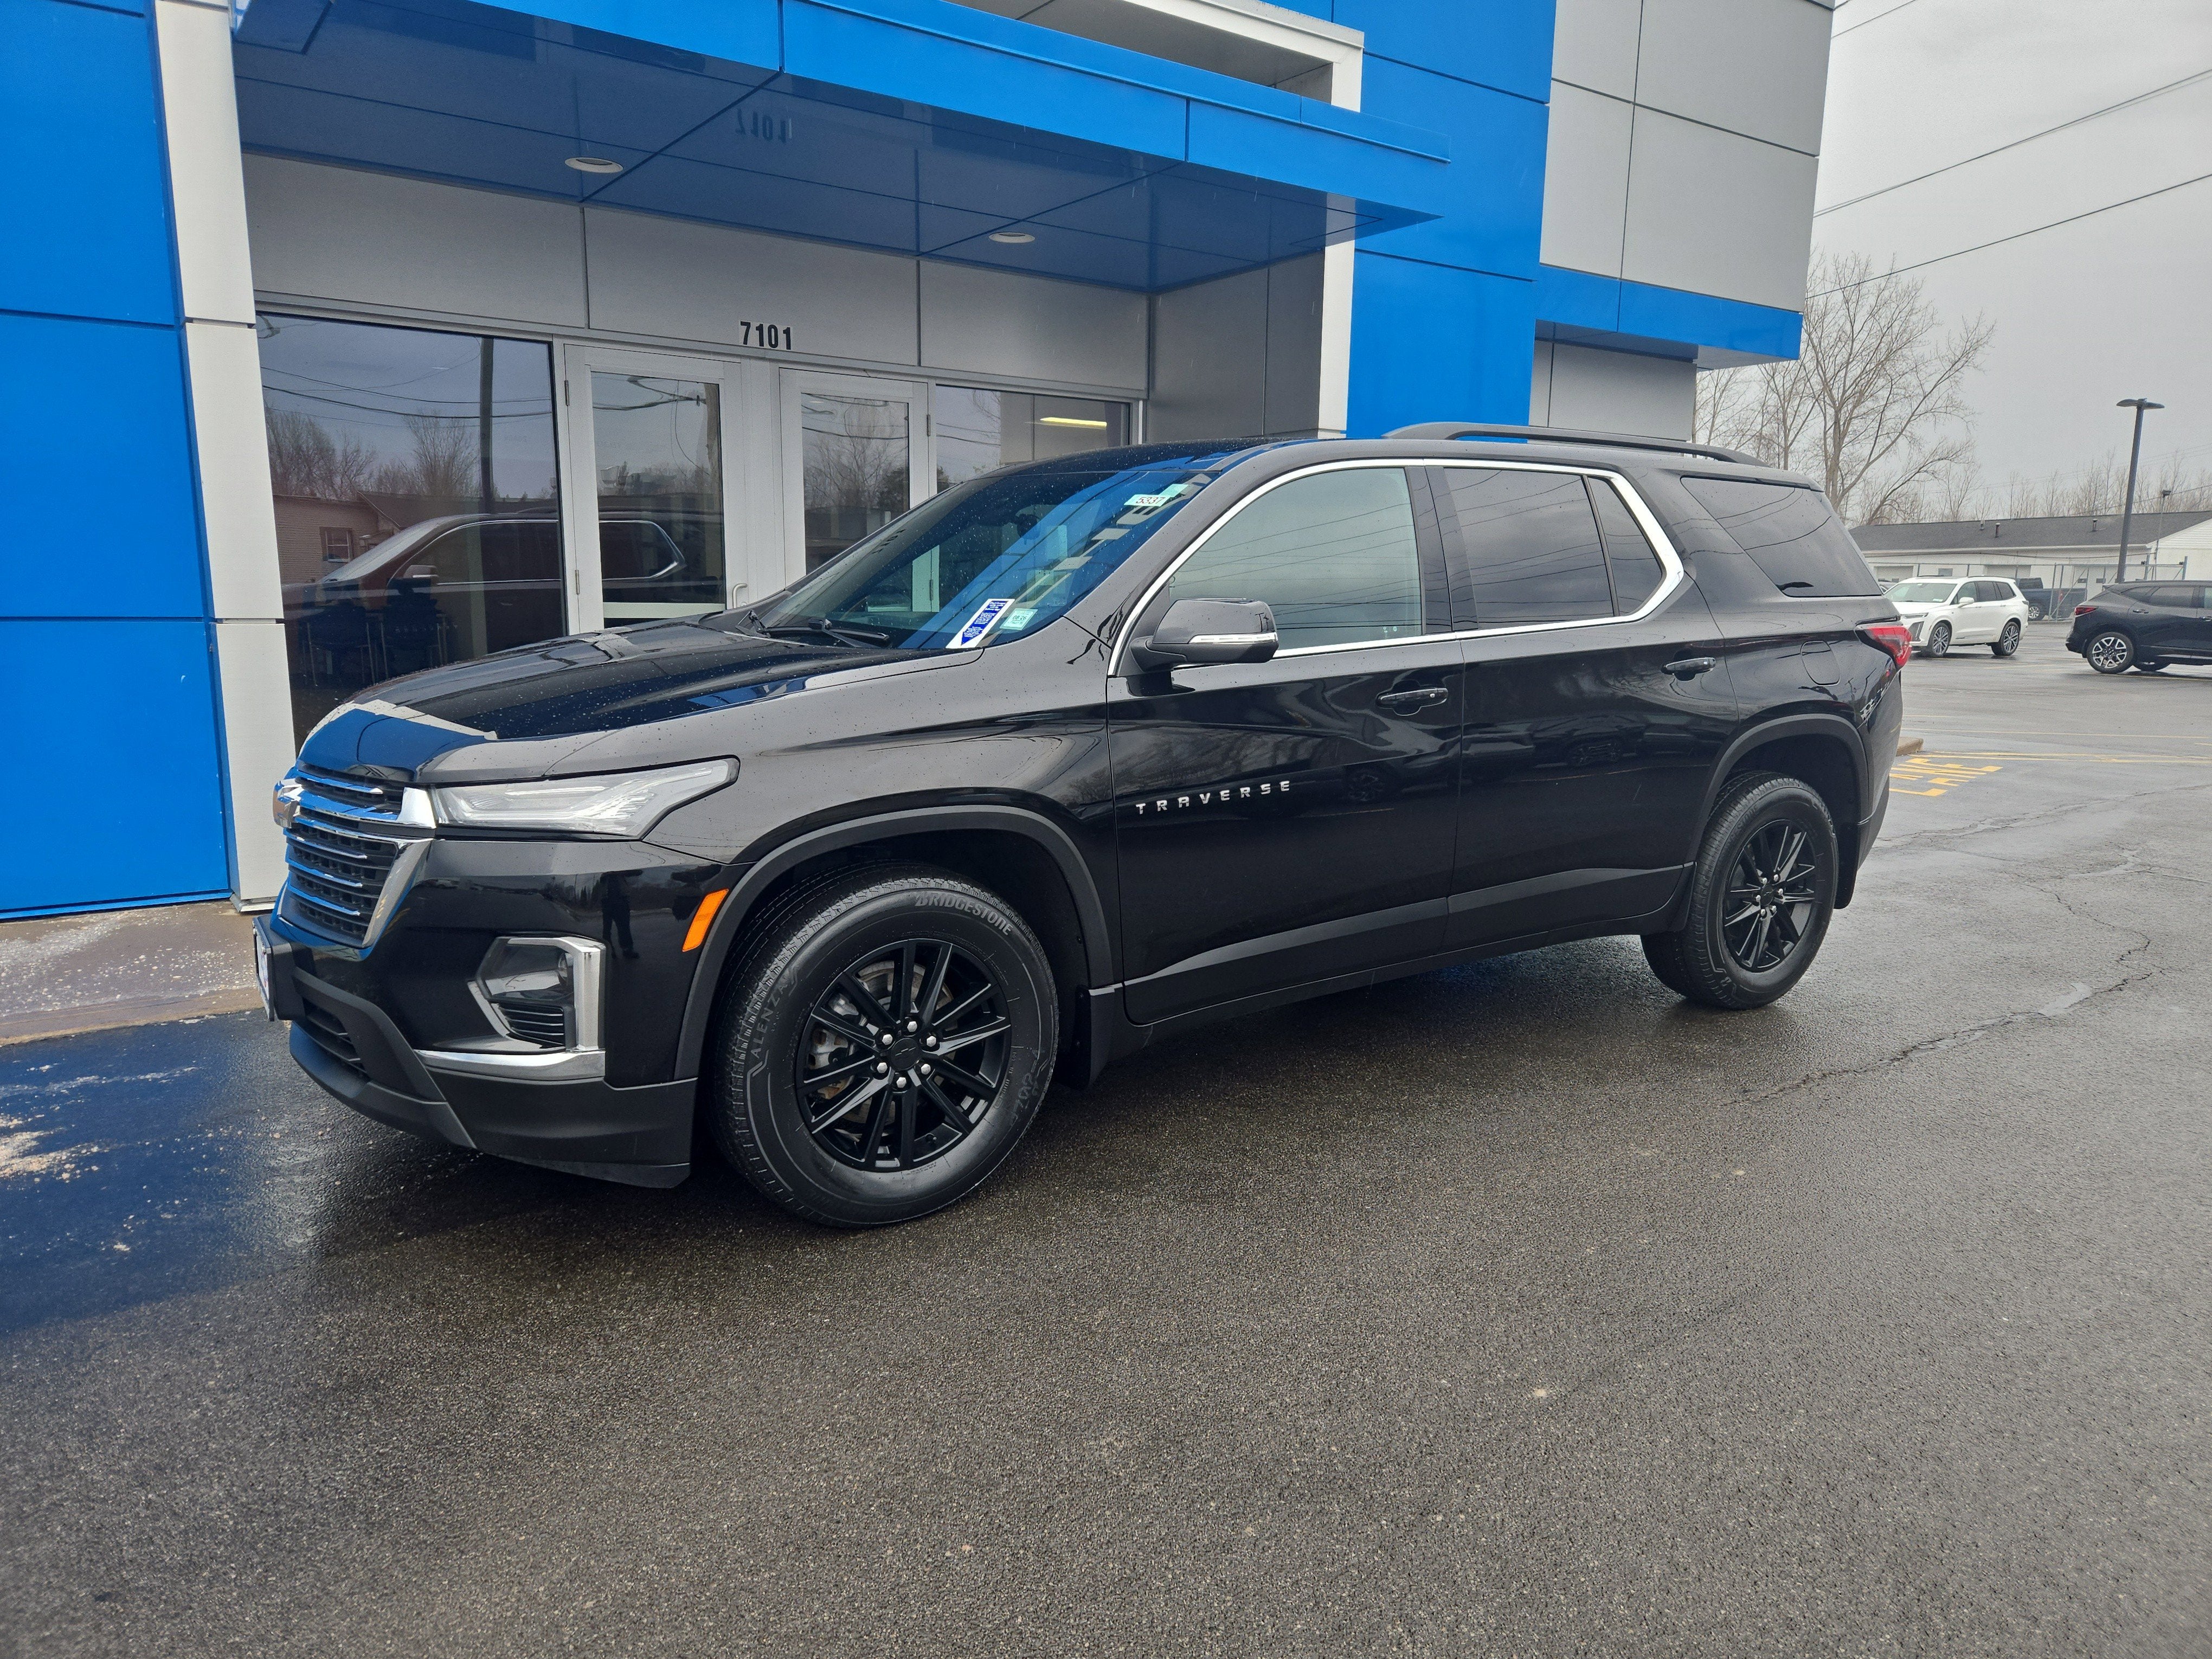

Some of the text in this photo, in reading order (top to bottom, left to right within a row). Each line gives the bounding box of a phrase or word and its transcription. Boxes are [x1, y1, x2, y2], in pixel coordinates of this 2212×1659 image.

[740, 321, 791, 350] 7101
[1136, 781, 1290, 814] TRAVERSE
[915, 892, 1013, 936] BRIDGESTONE
[751, 983, 788, 1058] ALENZA
